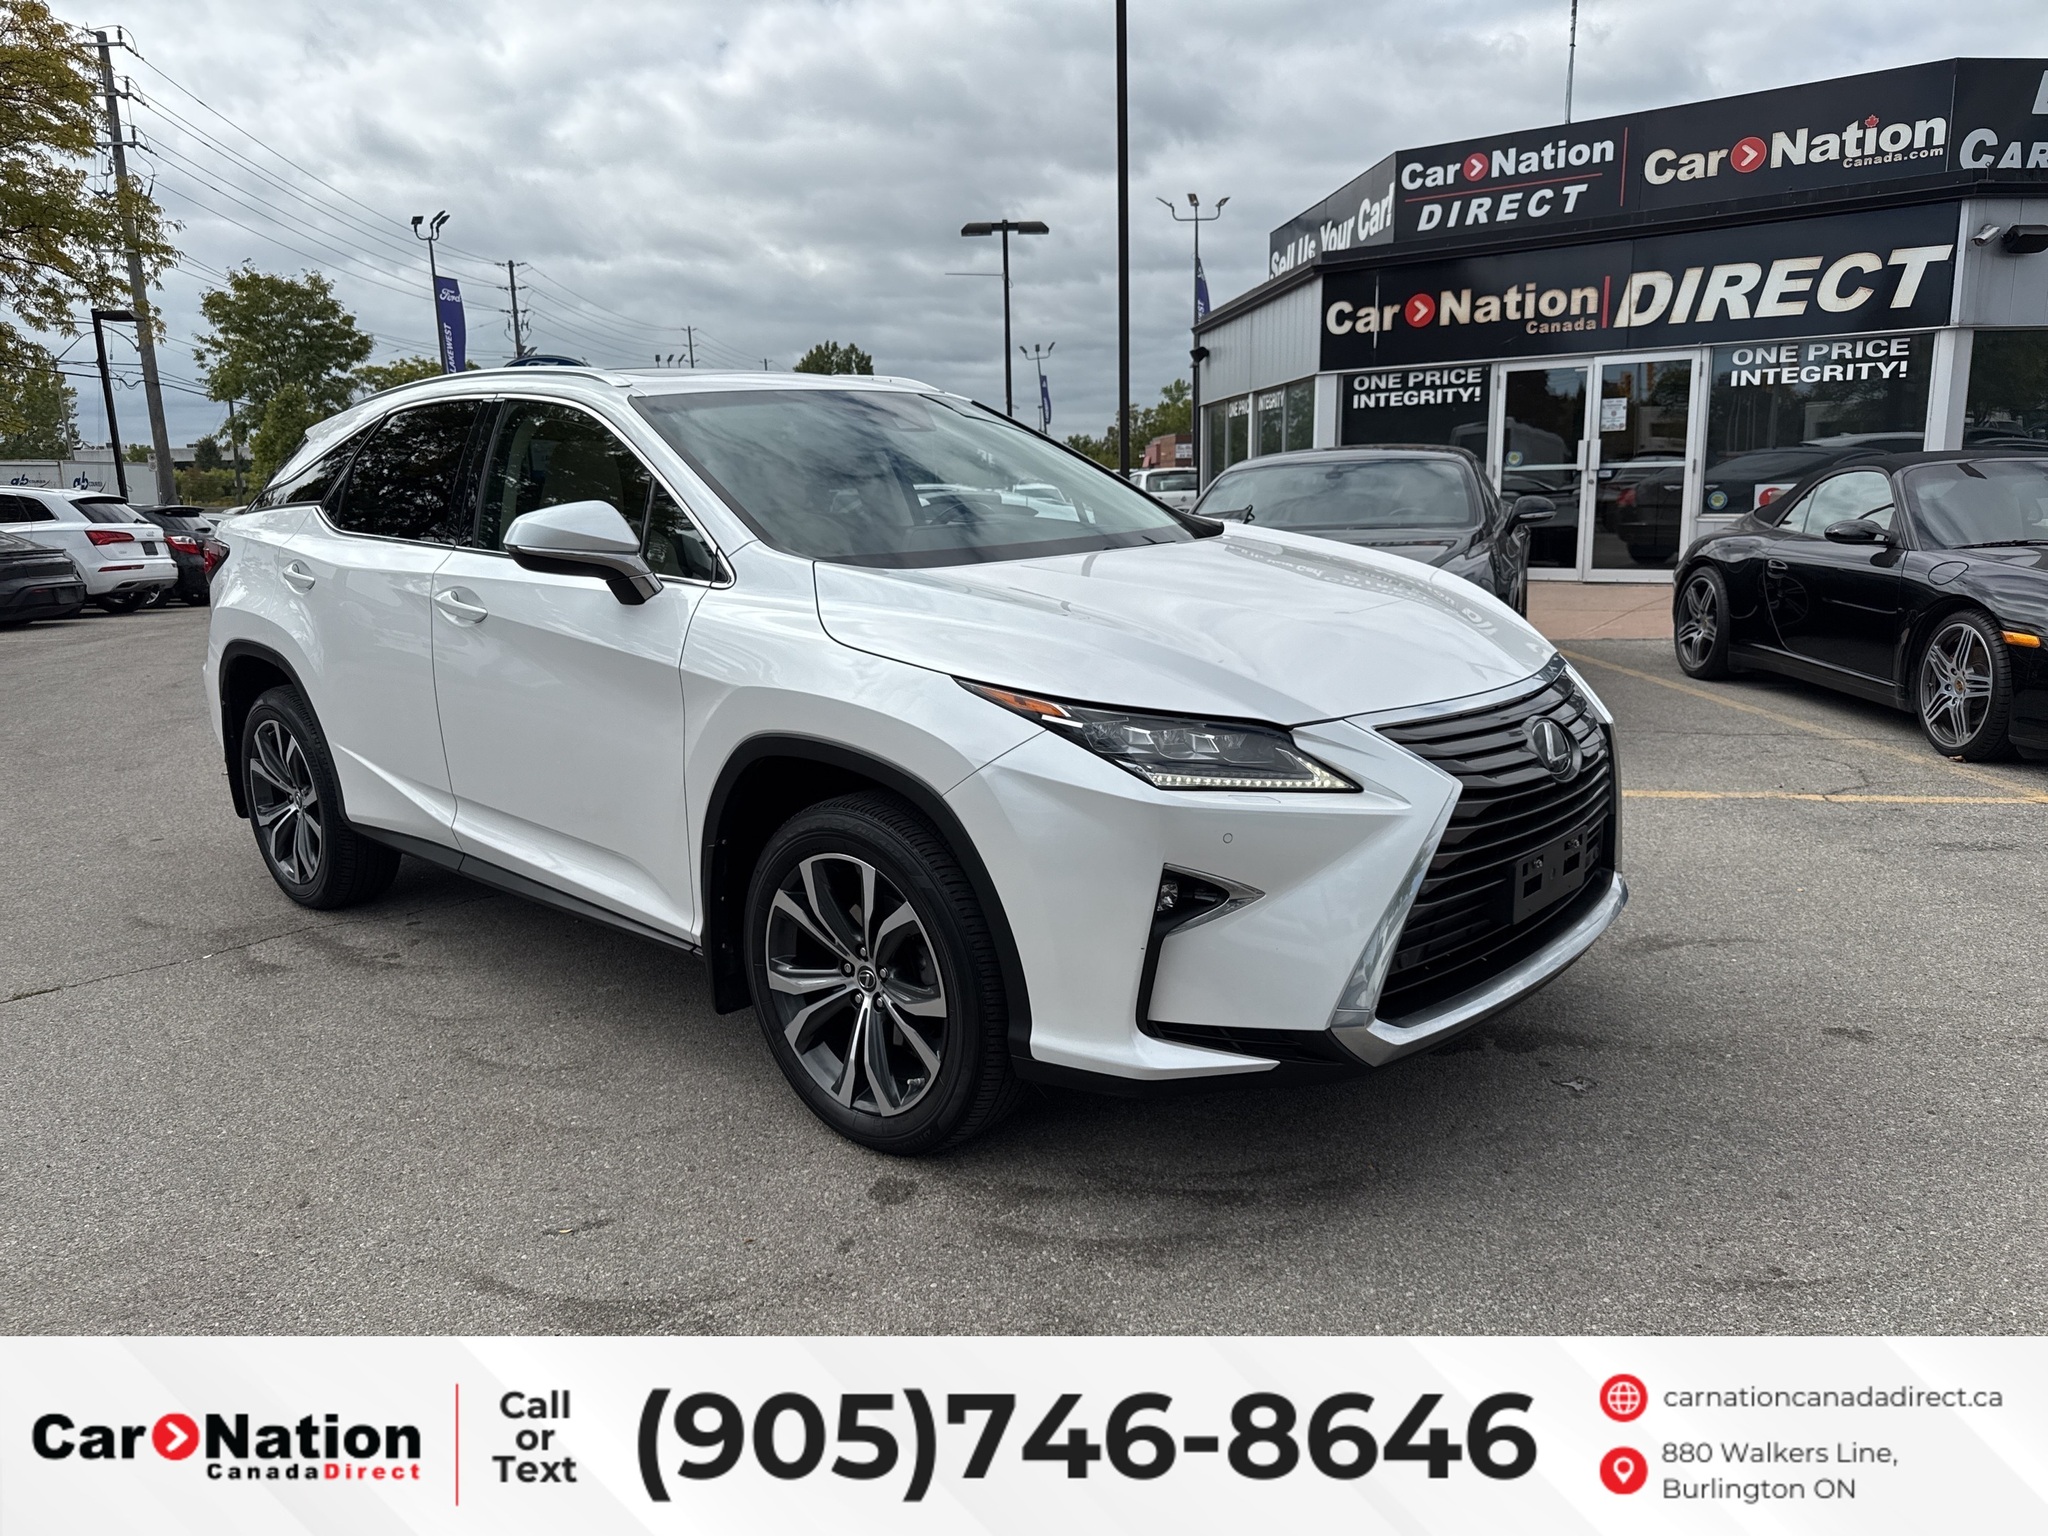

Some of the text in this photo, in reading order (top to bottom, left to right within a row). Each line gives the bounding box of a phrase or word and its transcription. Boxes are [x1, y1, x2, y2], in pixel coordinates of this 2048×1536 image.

[1401, 139, 1615, 190] Car Nation
[1643, 115, 1947, 186] Car Nation
[1842, 146, 1945, 169] Canada.com
[1320, 220, 1355, 252] Your
[1357, 181, 1395, 242] Car!
[1416, 183, 1589, 232] DIRECT
[440, 287, 461, 302] Ford
[1326, 243, 1954, 335] Car Nation DIRECT
[1525, 318, 1597, 335] Canada
[443, 322, 457, 374] LAKEWEST
[1732, 337, 1911, 367] ONE PRICE
[1353, 367, 1482, 391] ONE PRICE
[1730, 360, 1908, 387] INTEGRITY!
[1352, 386, 1481, 409] INTEGRITY!
